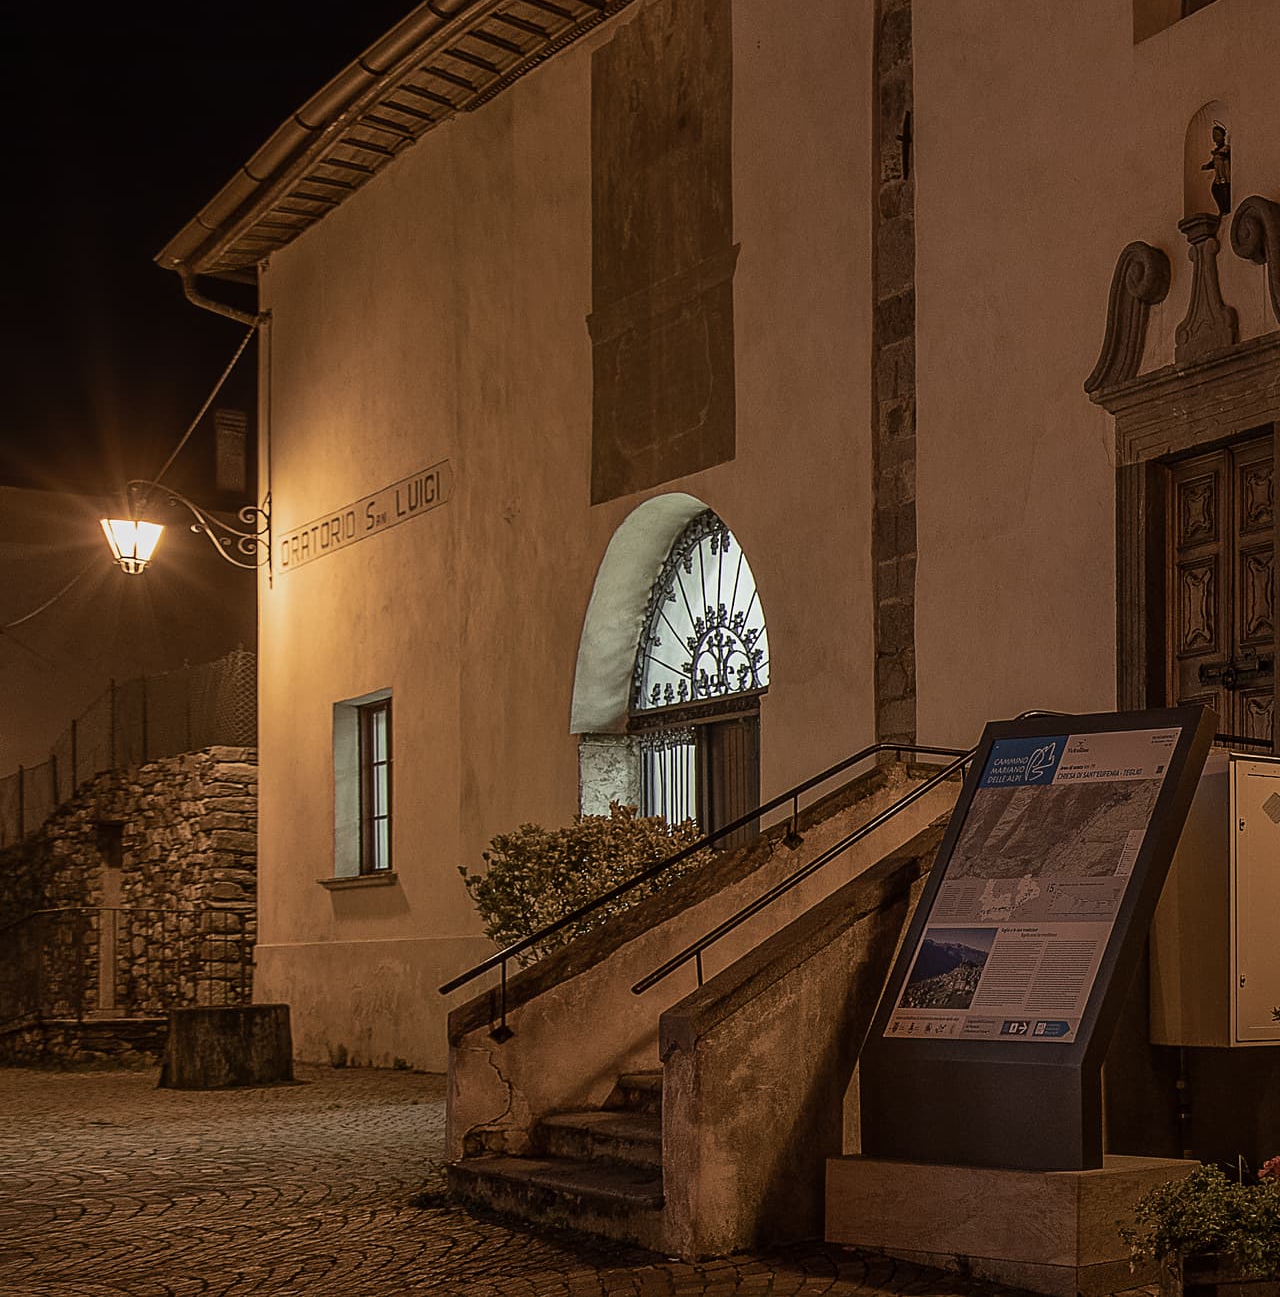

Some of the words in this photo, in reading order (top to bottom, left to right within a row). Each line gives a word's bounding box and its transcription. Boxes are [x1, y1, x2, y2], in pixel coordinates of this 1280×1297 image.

[281, 510, 355, 566] ORATORIO
[396, 471, 440, 517] LUIGI
[994, 756, 1028, 766] CAMMINO
[990, 766, 1025, 774] MARIANO
[988, 775, 1006, 784] DELLE
[1006, 774, 1022, 782] ALPI
